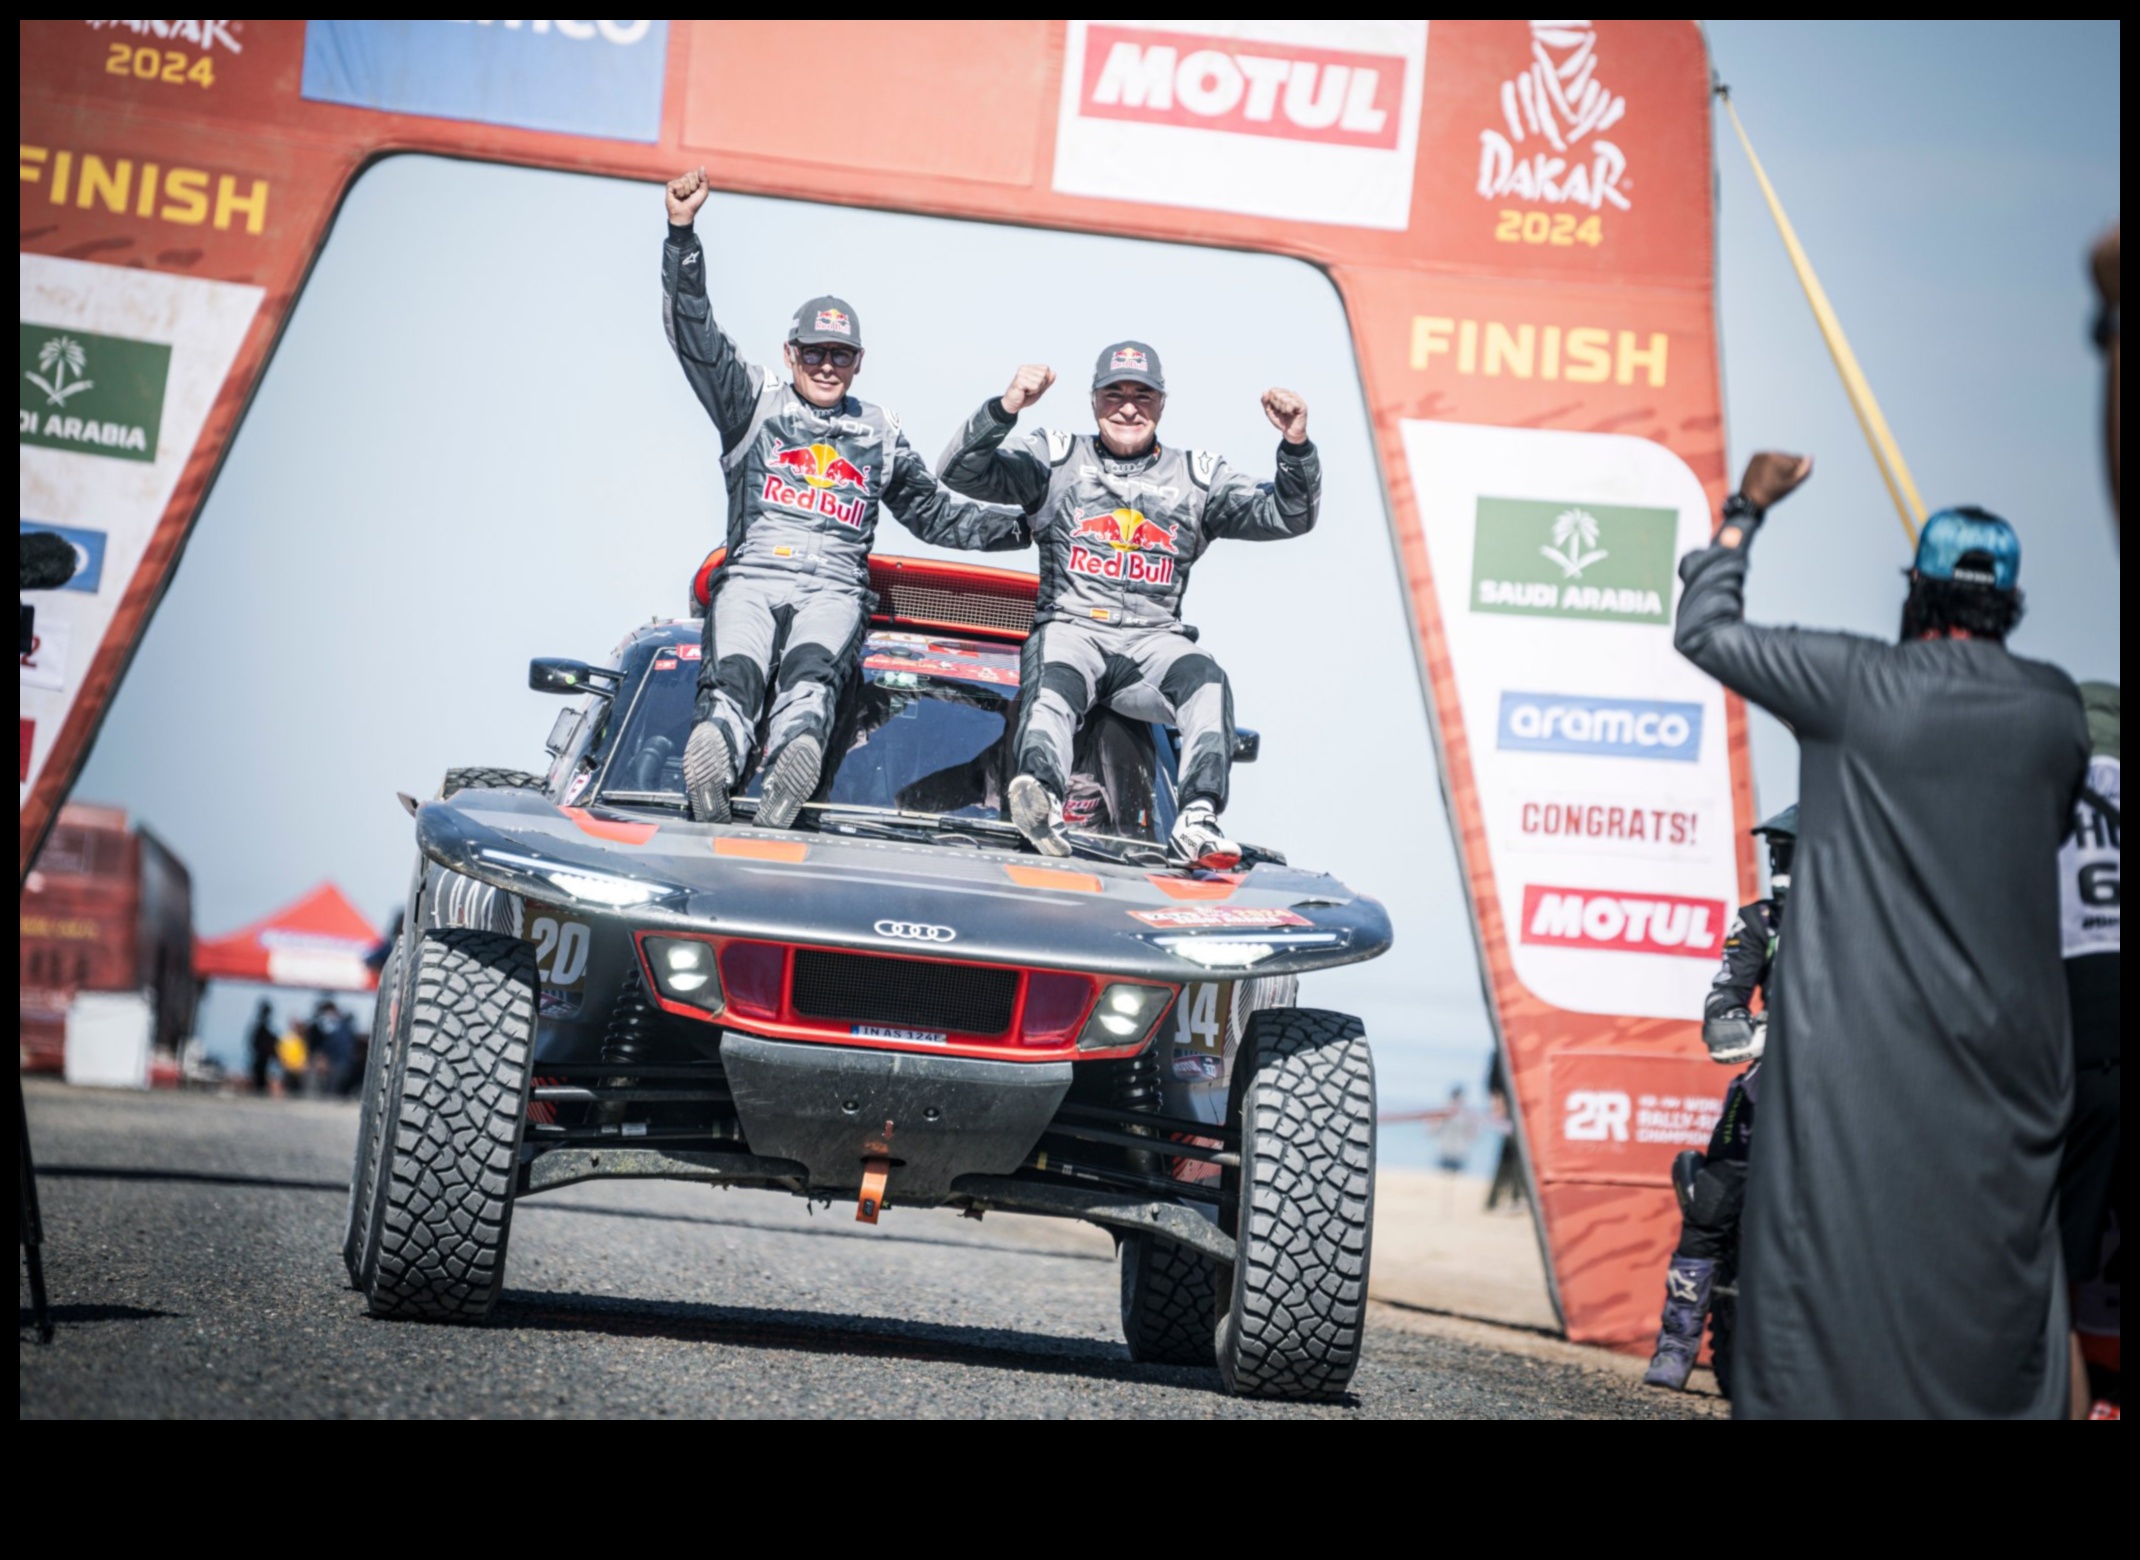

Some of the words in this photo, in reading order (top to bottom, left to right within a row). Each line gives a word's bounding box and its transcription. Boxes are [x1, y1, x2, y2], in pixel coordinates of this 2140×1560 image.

[106, 43, 215, 88] 2024
[1092, 42, 1388, 134] MOTUL
[1477, 129, 1632, 212] DAKAR
[1495, 209, 1604, 248] 2024
[1410, 315, 1669, 388] FINISH
[43, 414, 146, 452] ARABIA
[763, 474, 816, 511] Red
[819, 489, 866, 529] Bull
[1069, 545, 1123, 578] Red
[1128, 553, 1174, 584] Bull
[1478, 580, 1558, 608] SAUDI
[1562, 586, 1662, 615] ARABIA
[1509, 704, 1690, 747] aramco
[1522, 803, 1698, 845] CONGRATS!
[1530, 894, 1715, 949] MOTUL
[531, 917, 591, 985] 20
